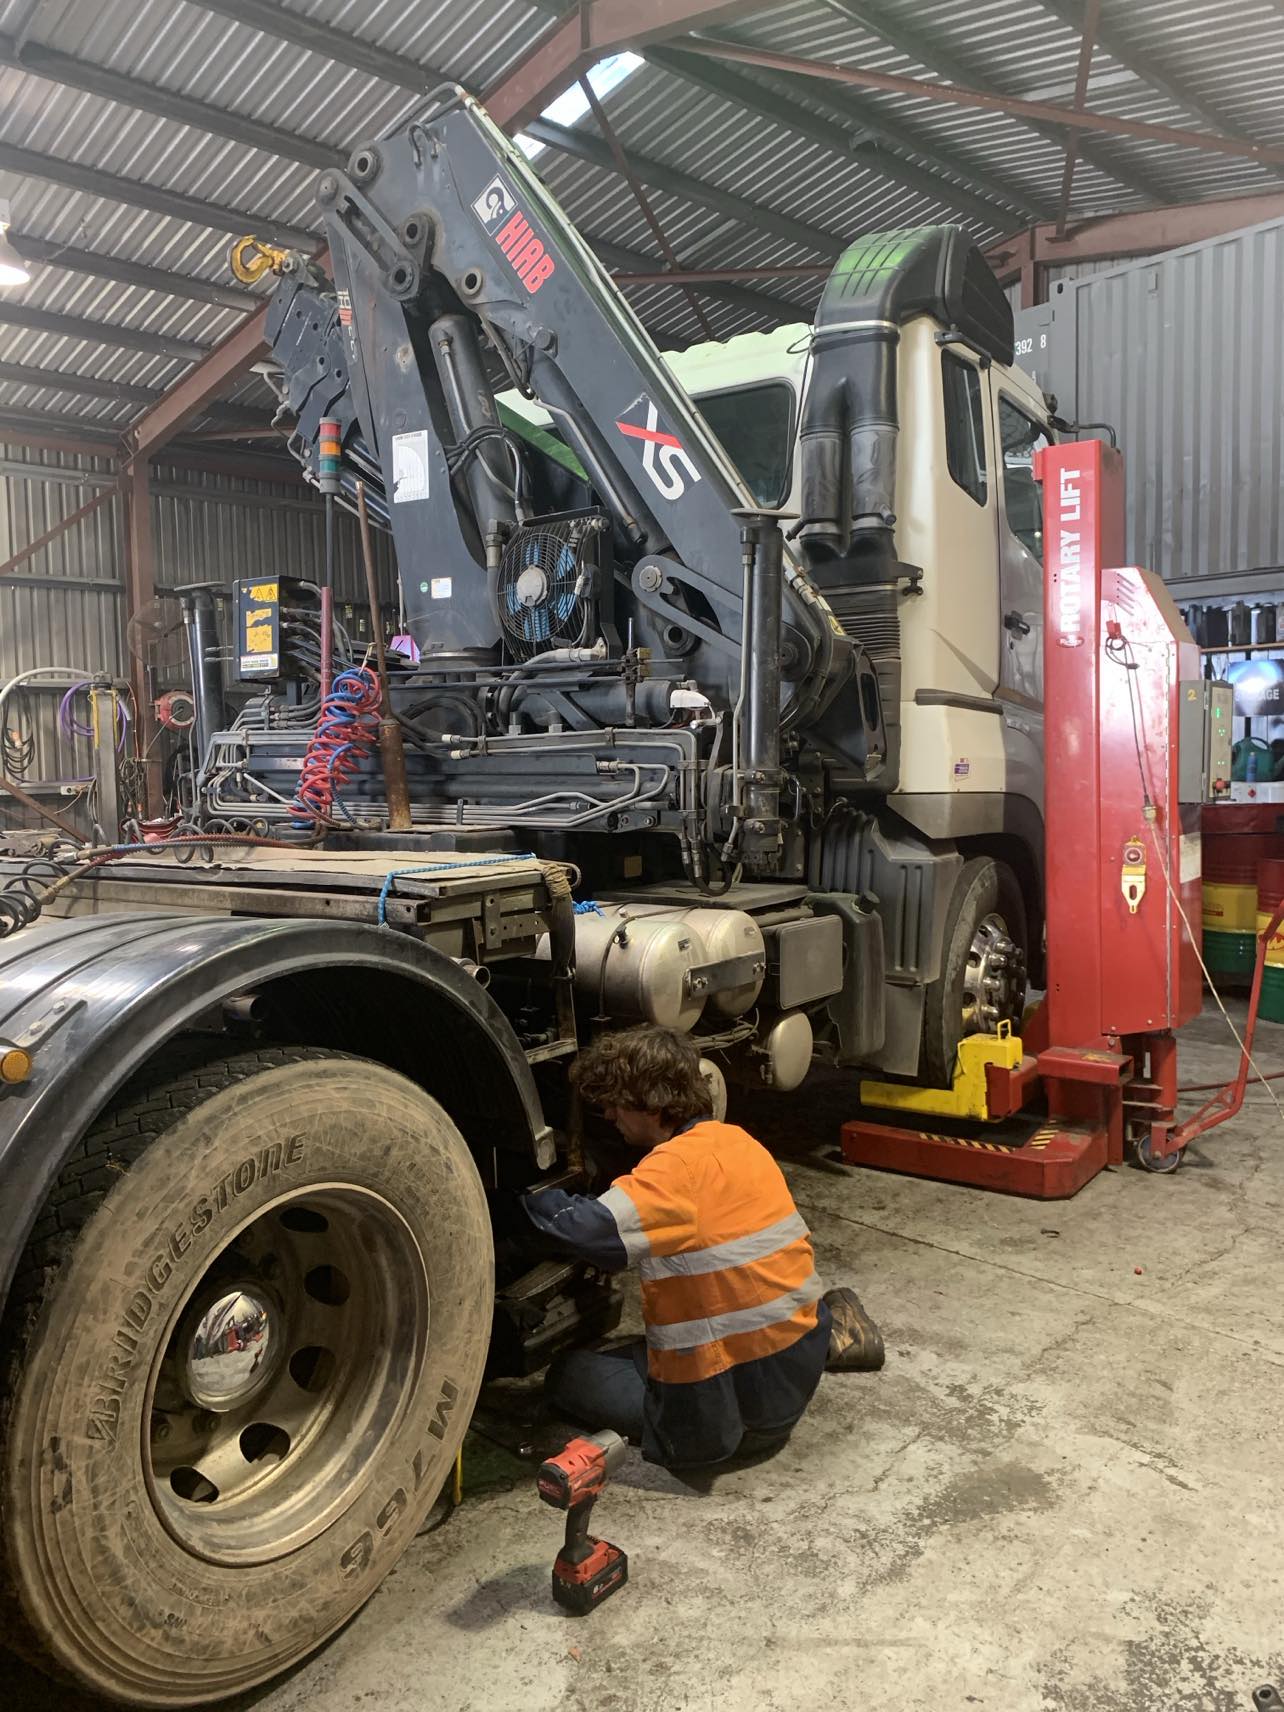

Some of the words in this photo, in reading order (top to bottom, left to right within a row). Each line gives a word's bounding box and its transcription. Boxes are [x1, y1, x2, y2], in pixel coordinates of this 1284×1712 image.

[495, 210, 555, 294] HIAB
[1040, 333, 1047, 349] 8
[615, 400, 702, 500] XS
[1060, 467, 1081, 522] LIFT
[1060, 530, 1081, 633] ROTARY
[1186, 688, 1197, 701] 2
[87, 1132, 307, 1447] BRIDGESTONE
[338, 1376, 460, 1580] M766
